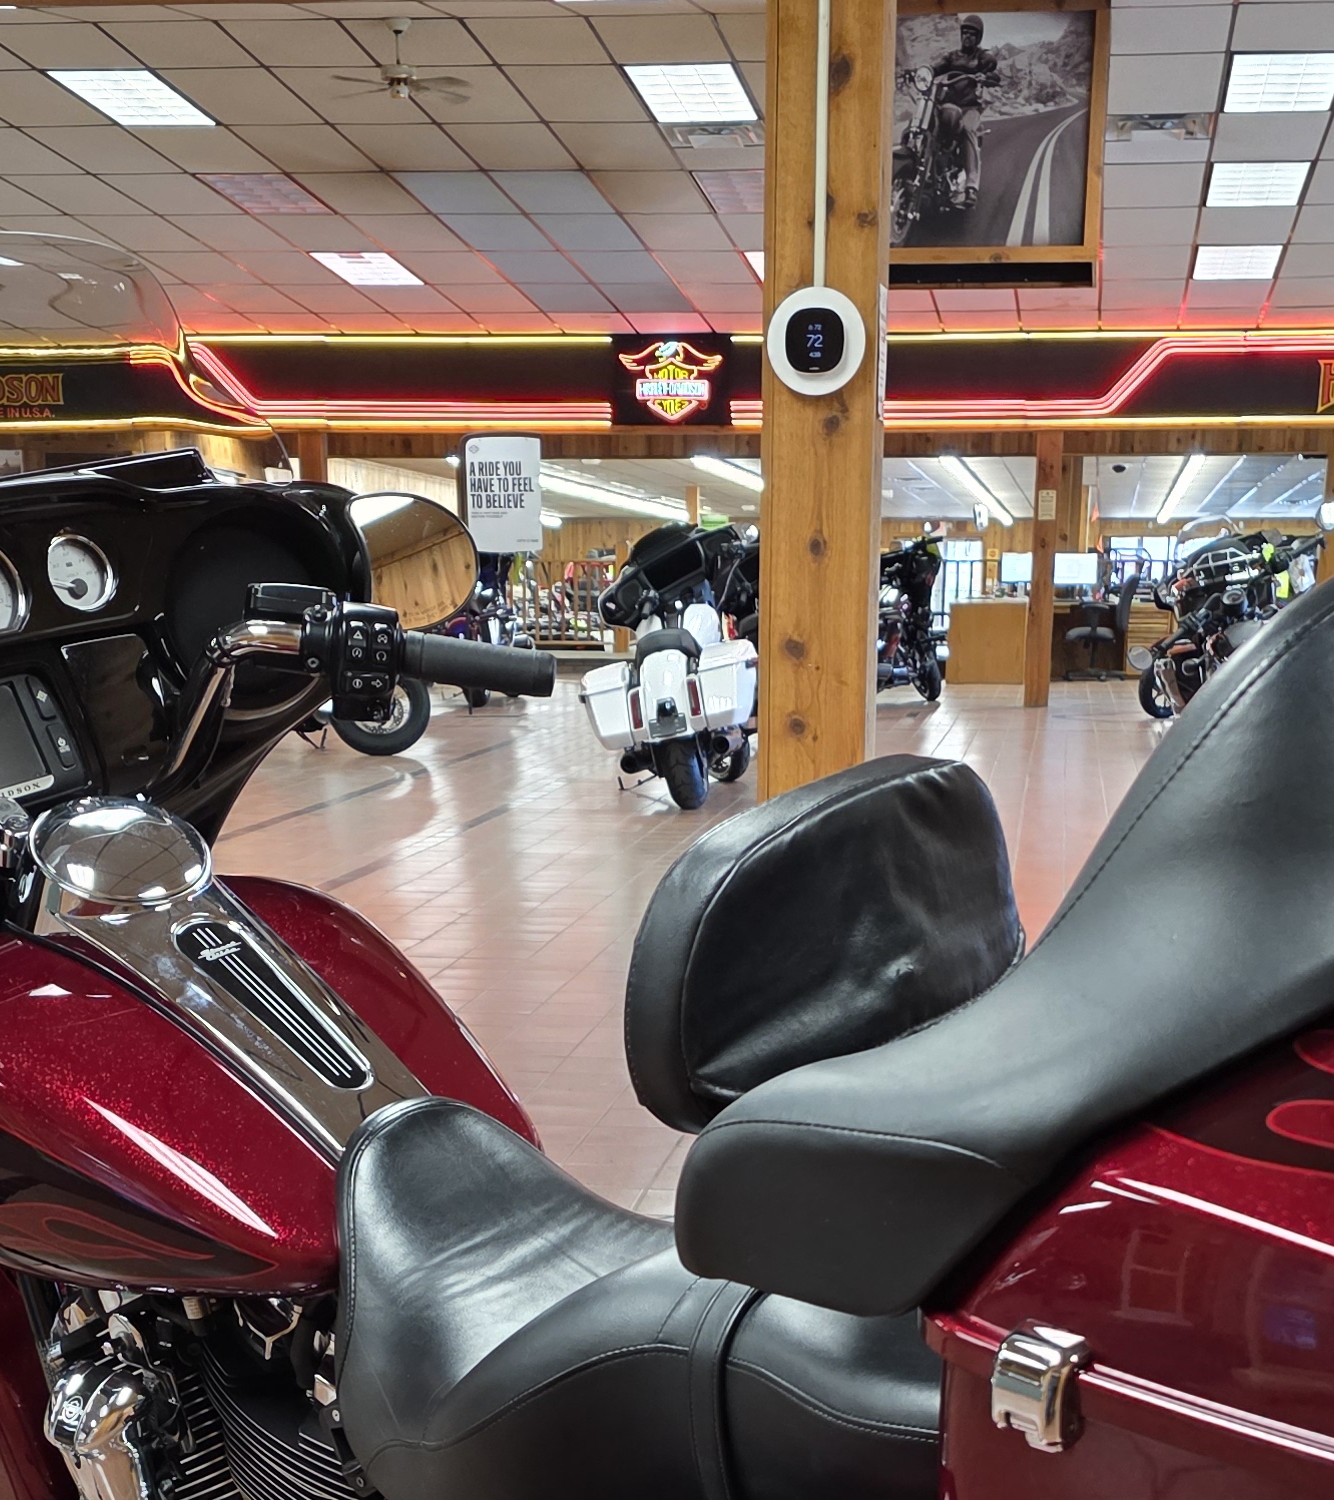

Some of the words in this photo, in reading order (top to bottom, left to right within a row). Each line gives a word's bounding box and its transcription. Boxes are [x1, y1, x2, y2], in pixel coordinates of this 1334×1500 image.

[806, 334, 823, 347] 72
[7, 407, 19, 418] IN
[21, 407, 55, 418] U.S.A.
[470, 462, 476, 476] A
[478, 461, 501, 476] RIDE
[502, 461, 522, 476] YOU
[470, 478, 495, 493] HAVE
[498, 478, 509, 493] TO
[512, 477, 535, 492] FEEL
[470, 494, 483, 509] TO
[486, 493, 525, 509] BELIEVE
